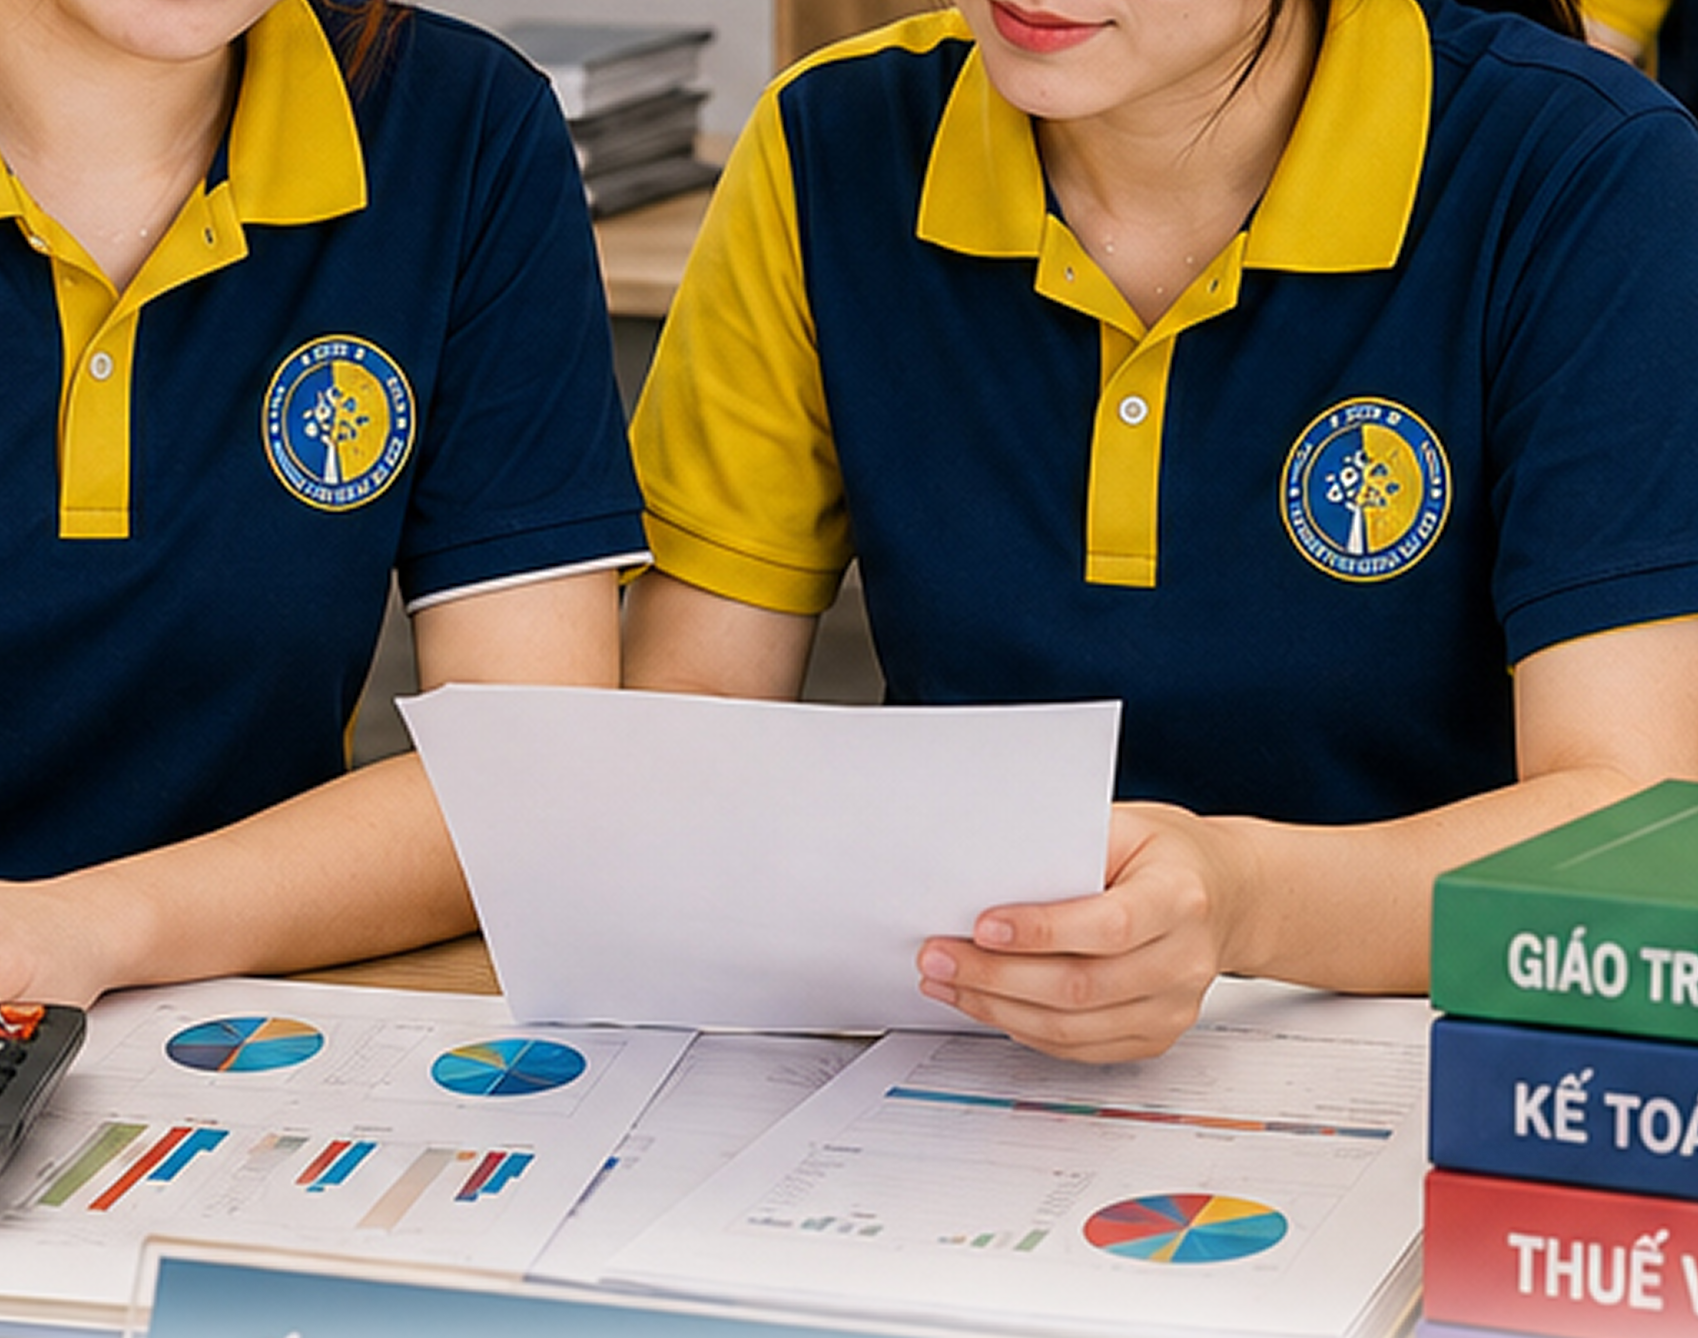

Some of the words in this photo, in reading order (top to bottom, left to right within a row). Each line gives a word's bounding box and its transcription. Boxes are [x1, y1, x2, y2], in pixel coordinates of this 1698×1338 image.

[1507, 925, 1629, 999] GIÁO
[1513, 1067, 1594, 1144] KẾ
[1506, 1228, 1671, 1311] THUẾ
